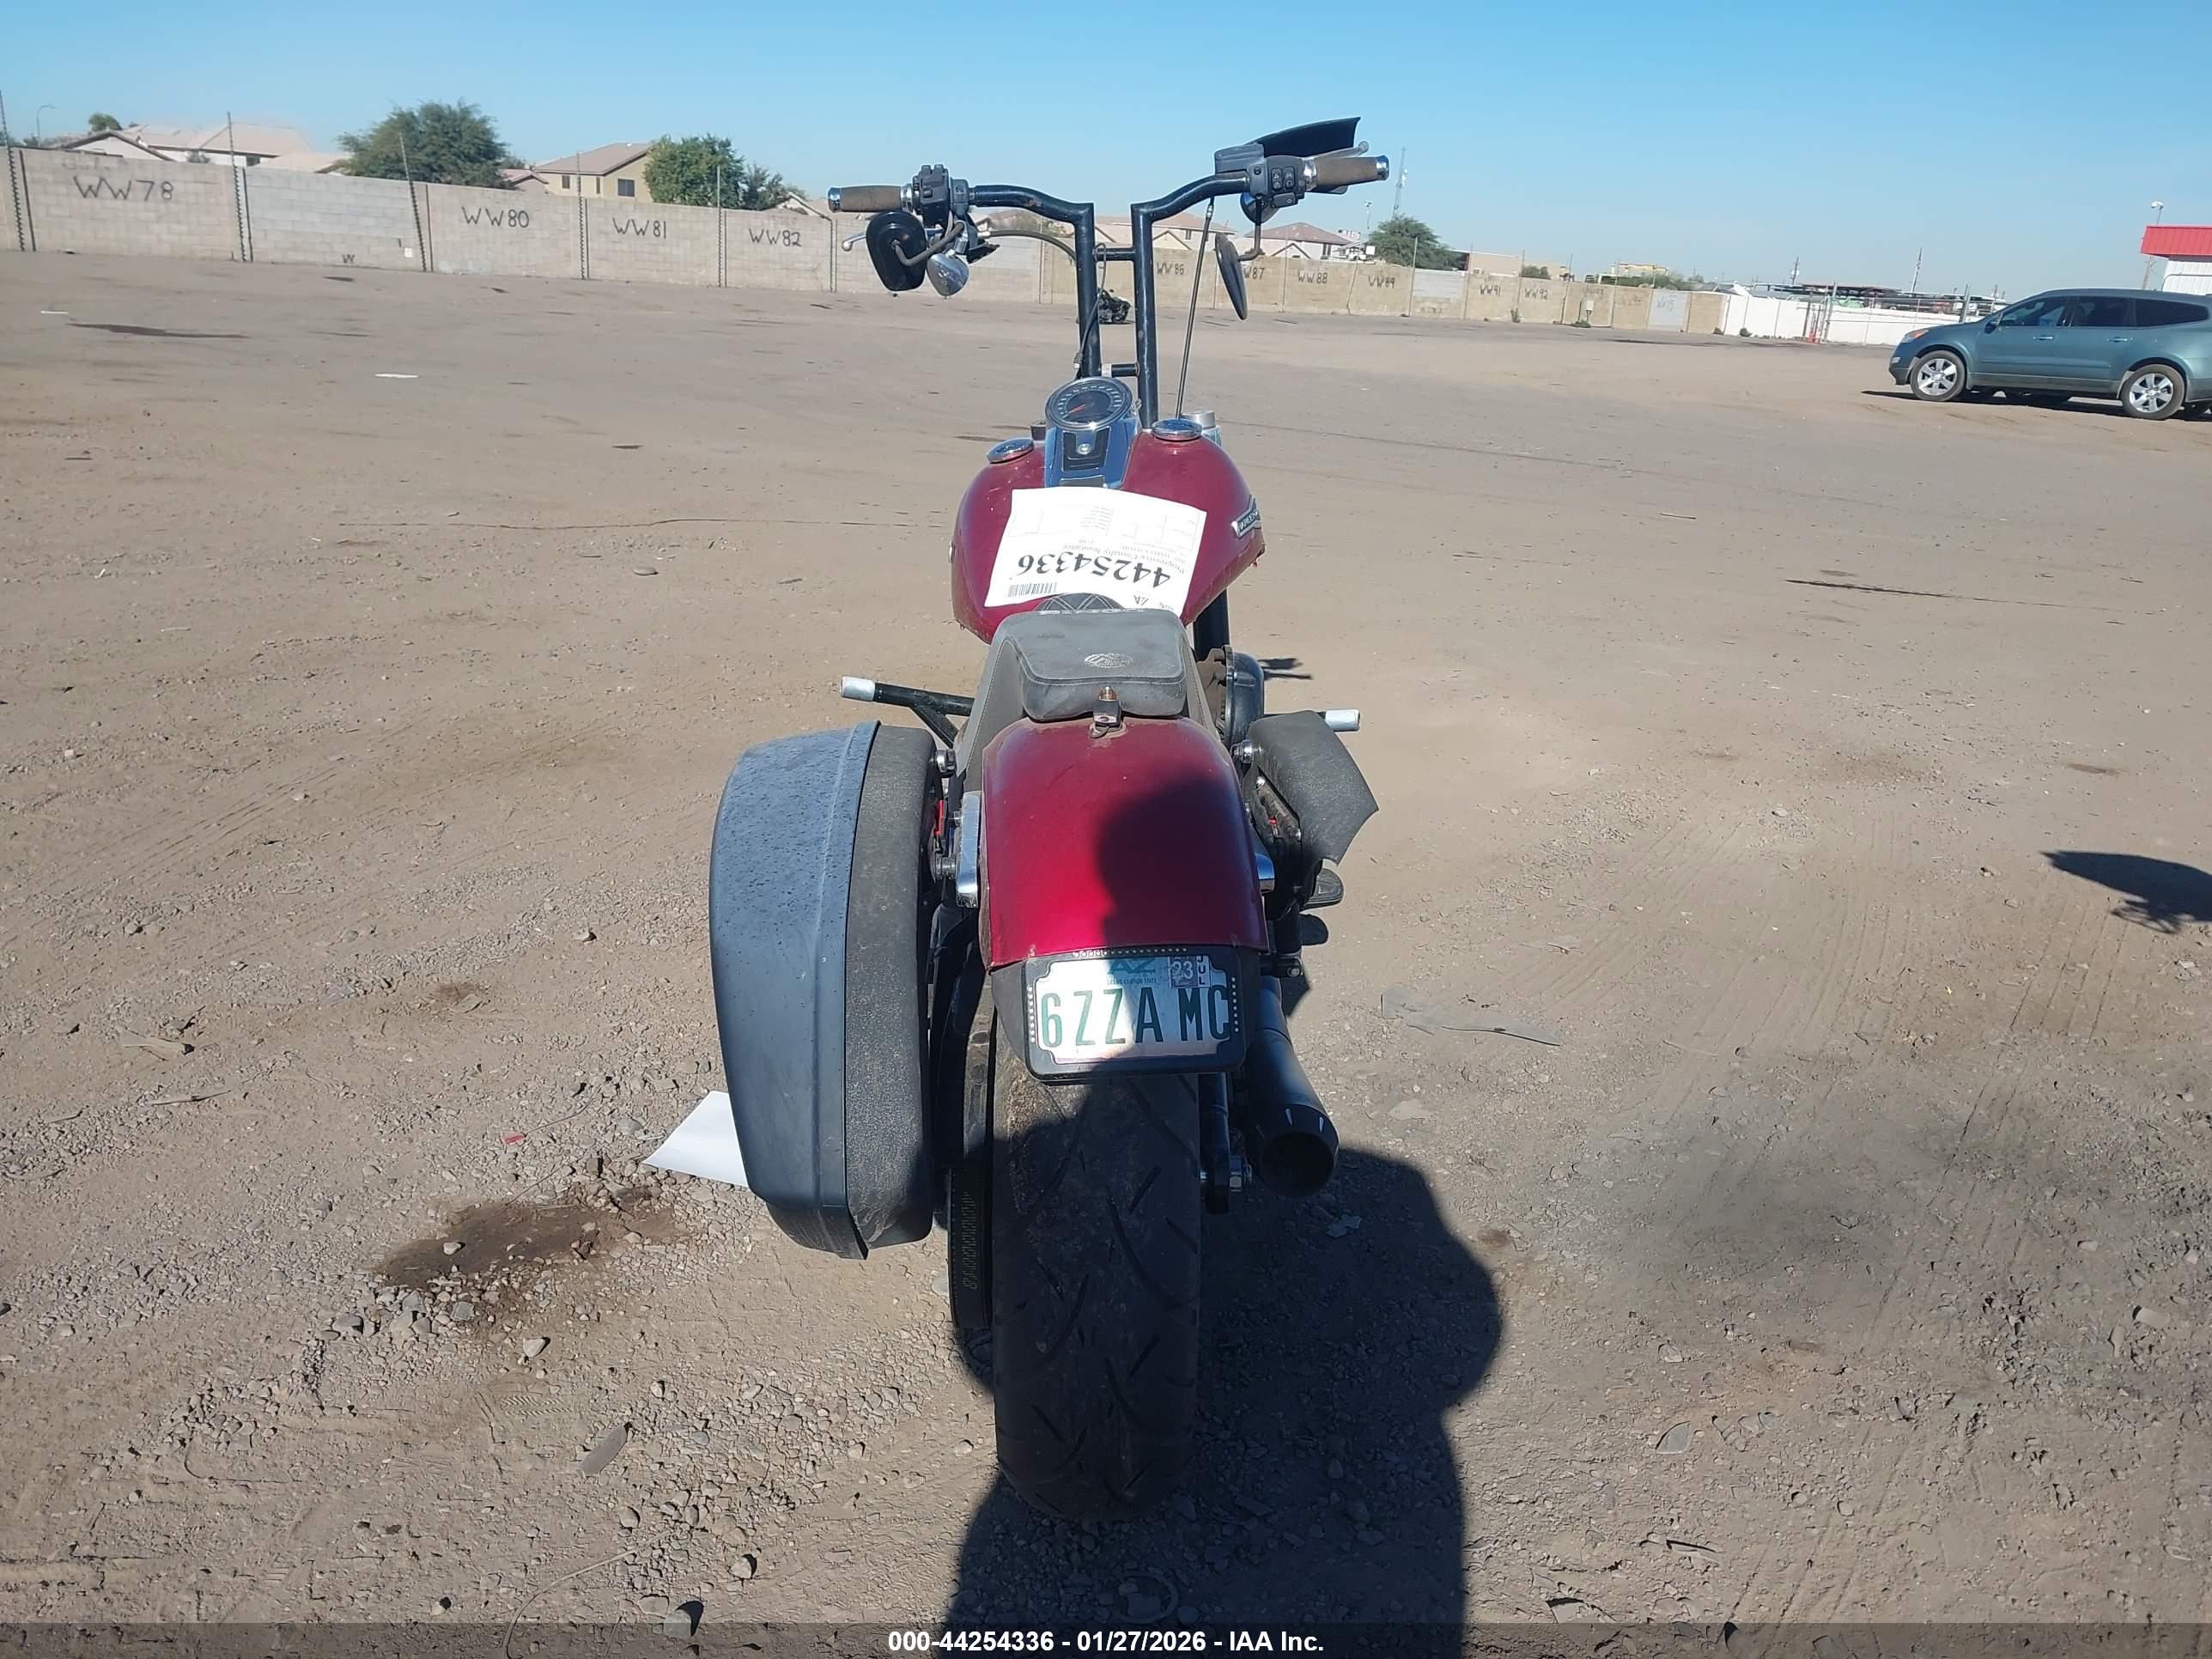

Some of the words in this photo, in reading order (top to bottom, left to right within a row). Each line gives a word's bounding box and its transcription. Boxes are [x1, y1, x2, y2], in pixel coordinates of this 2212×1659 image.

[73, 176, 173, 201] WW78
[461, 206, 530, 228] WW80
[611, 217, 667, 240] WW81
[748, 228, 802, 247] WW82
[1297, 270, 1328, 284] WW88
[1018, 554, 1170, 588] 44254336
[1171, 961, 1194, 979] 23
[1196, 956, 1206, 985] JUL
